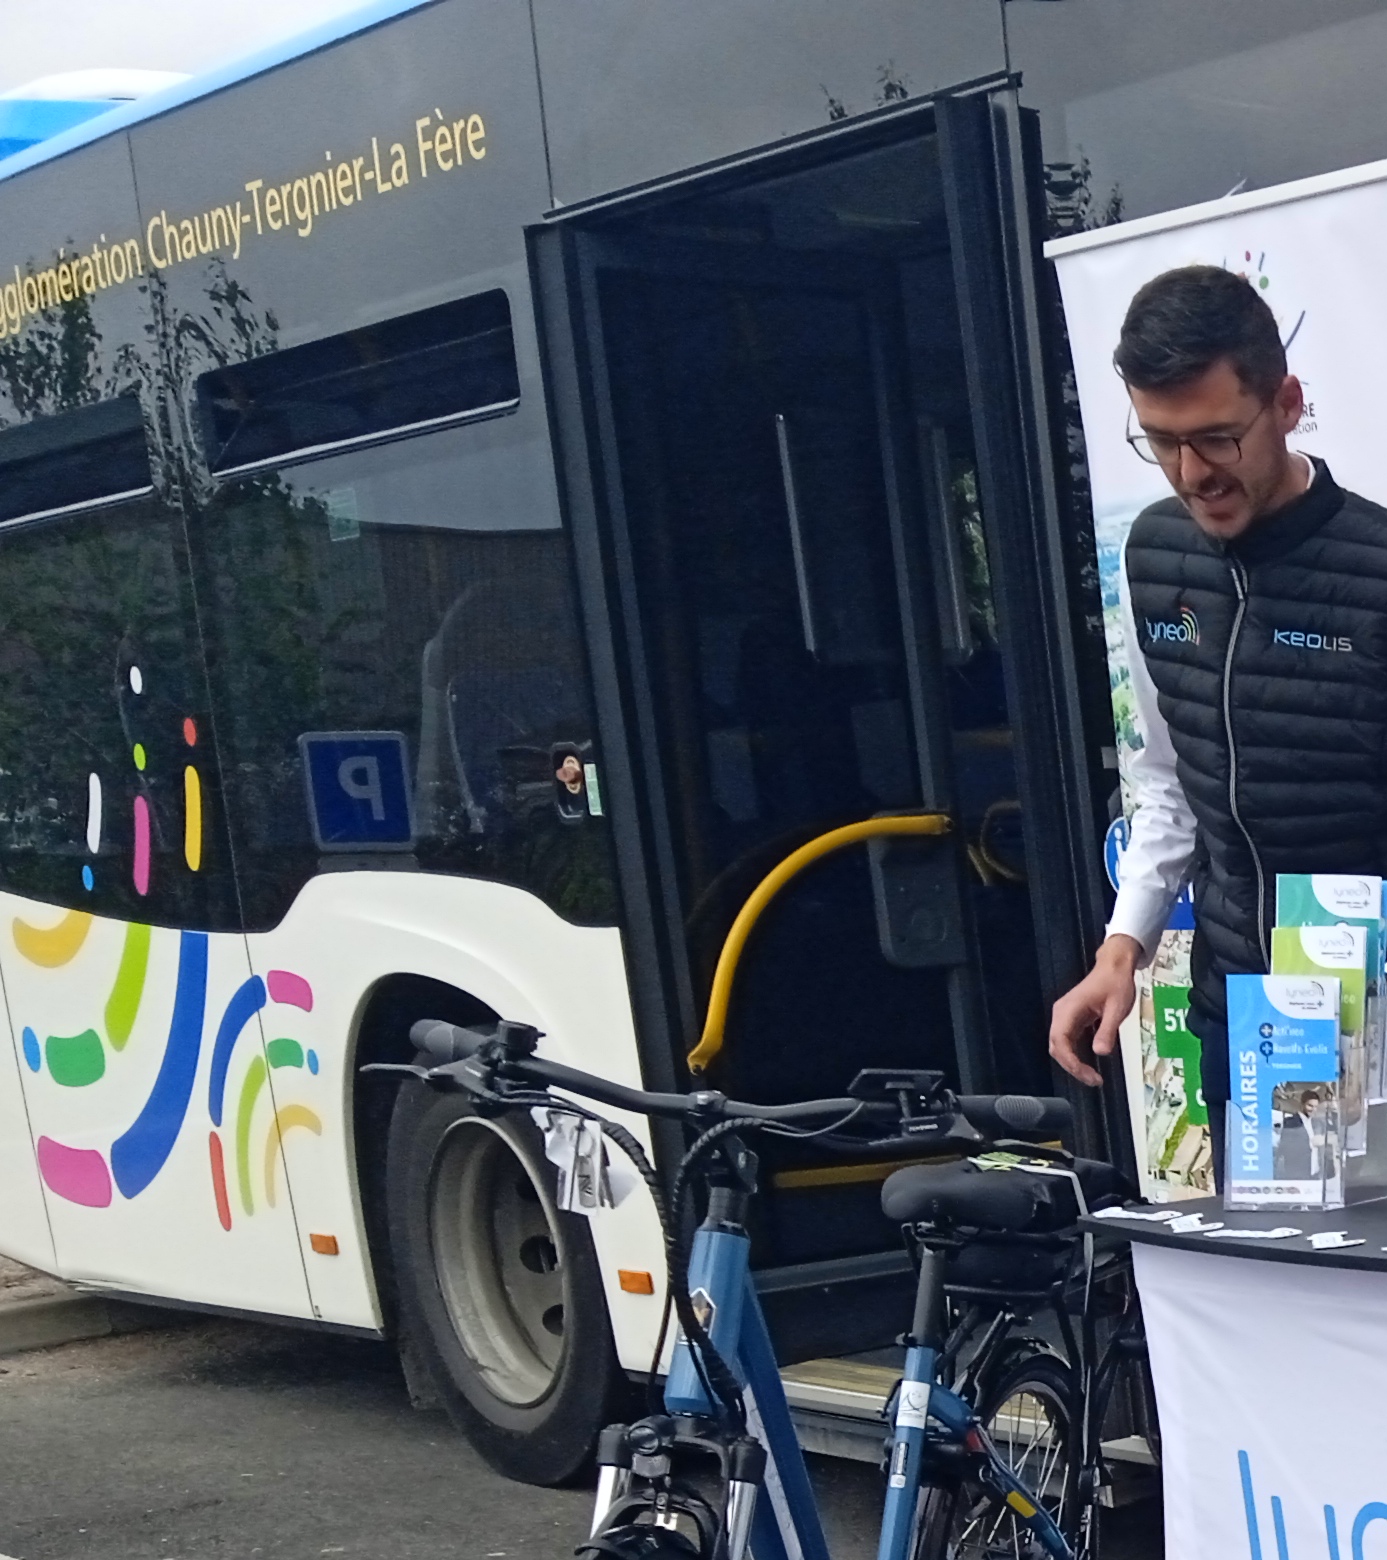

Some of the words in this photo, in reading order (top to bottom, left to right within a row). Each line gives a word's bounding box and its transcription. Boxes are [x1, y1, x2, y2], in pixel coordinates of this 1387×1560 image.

[147, 137, 409, 269] Chauny-Tergnier-La
[416, 108, 487, 179] Fère
[1239, 1050, 1260, 1172] HORAIRES
